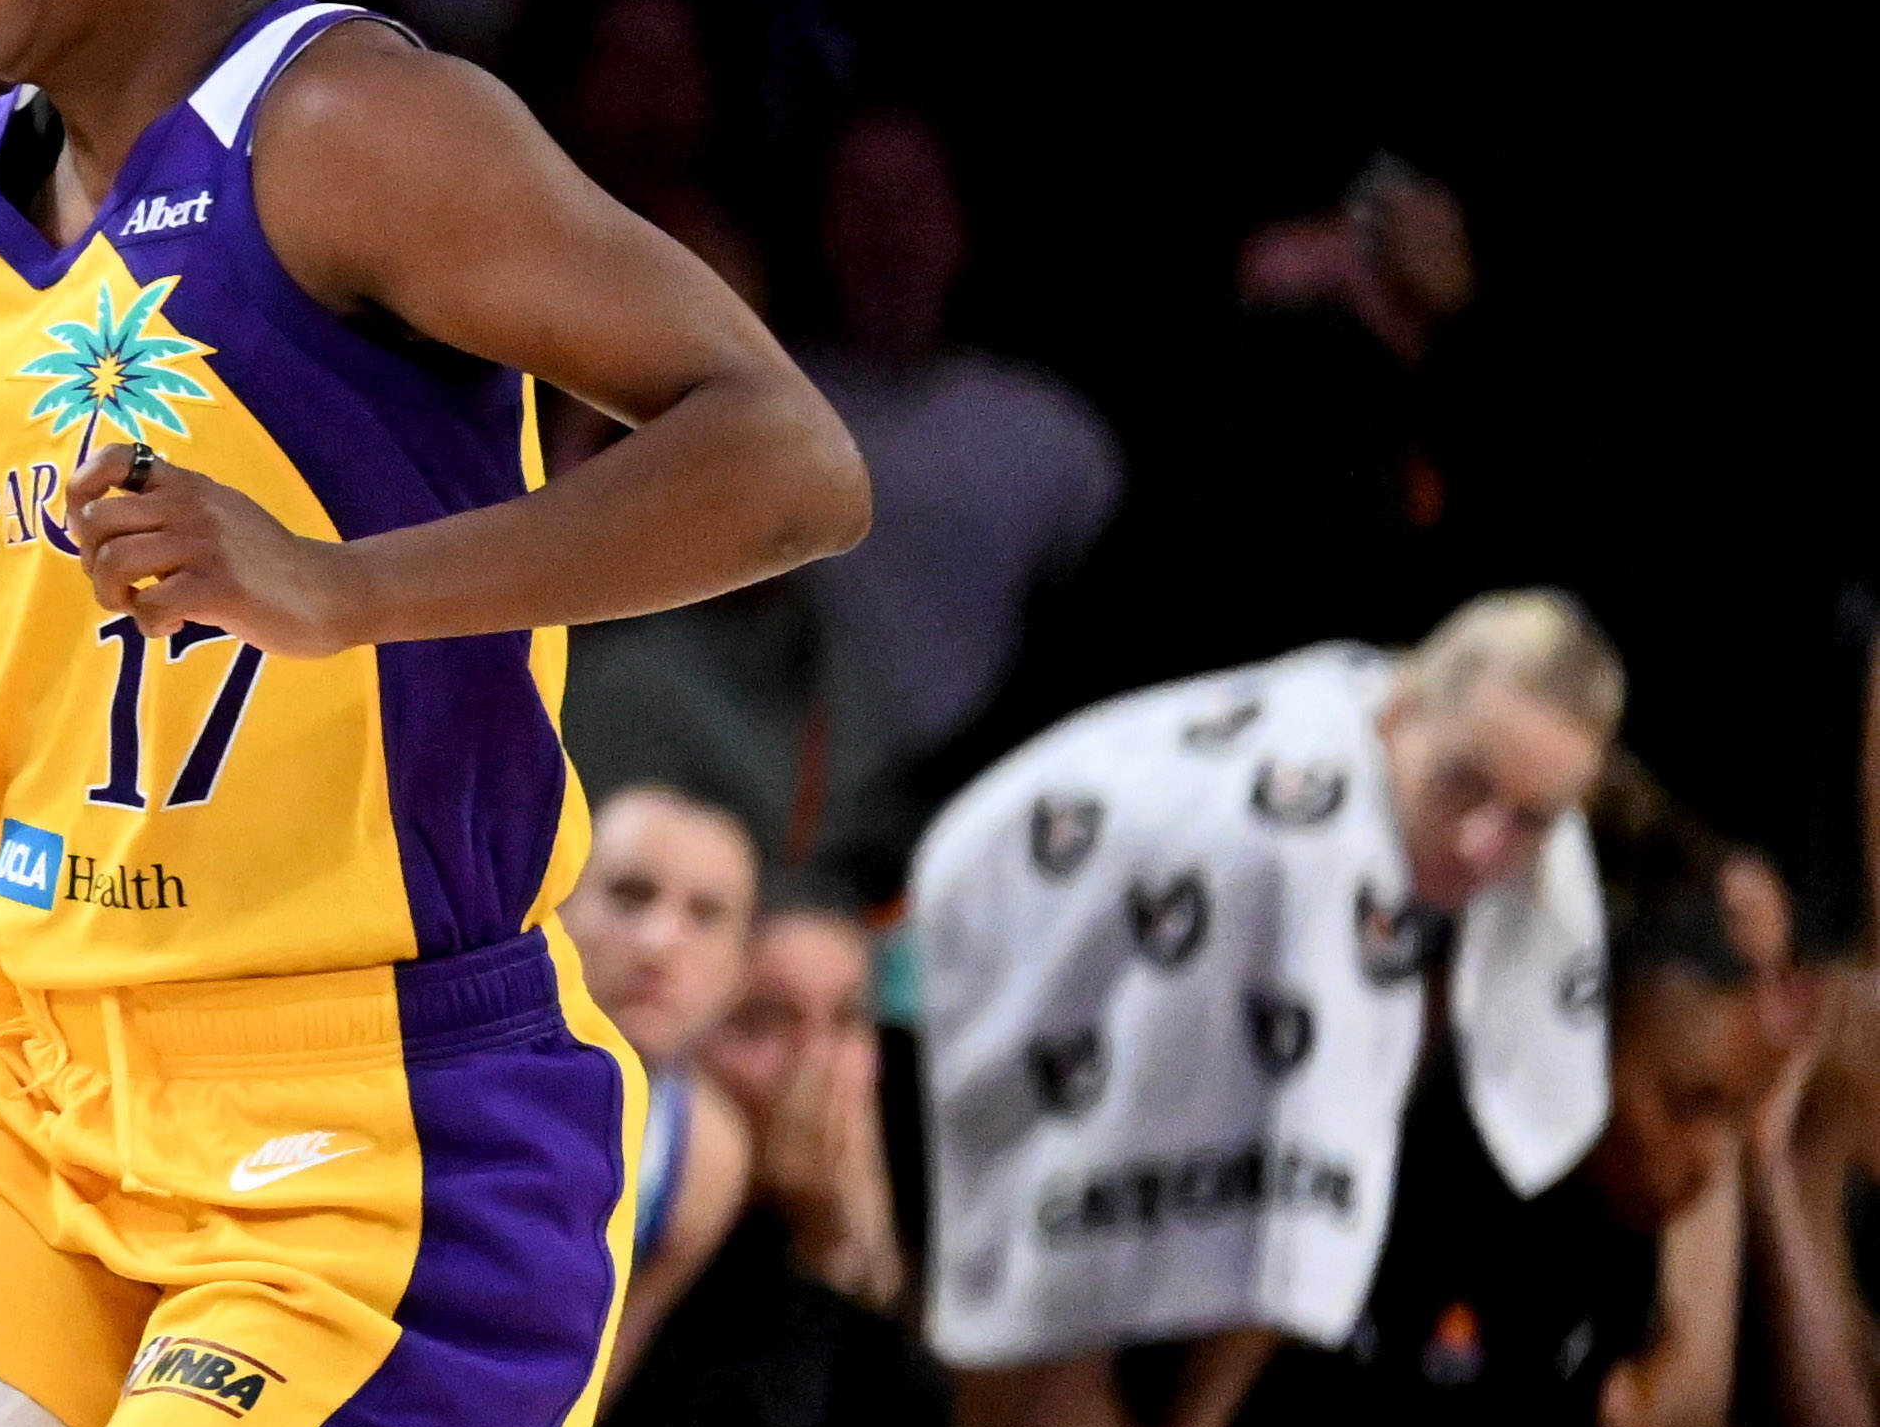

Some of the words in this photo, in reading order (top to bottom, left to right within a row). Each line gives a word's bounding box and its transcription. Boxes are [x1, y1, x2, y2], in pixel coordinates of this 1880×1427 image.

[119, 190, 213, 236] Albert
[87, 614, 268, 813] 17
[64, 854, 188, 910] Health
